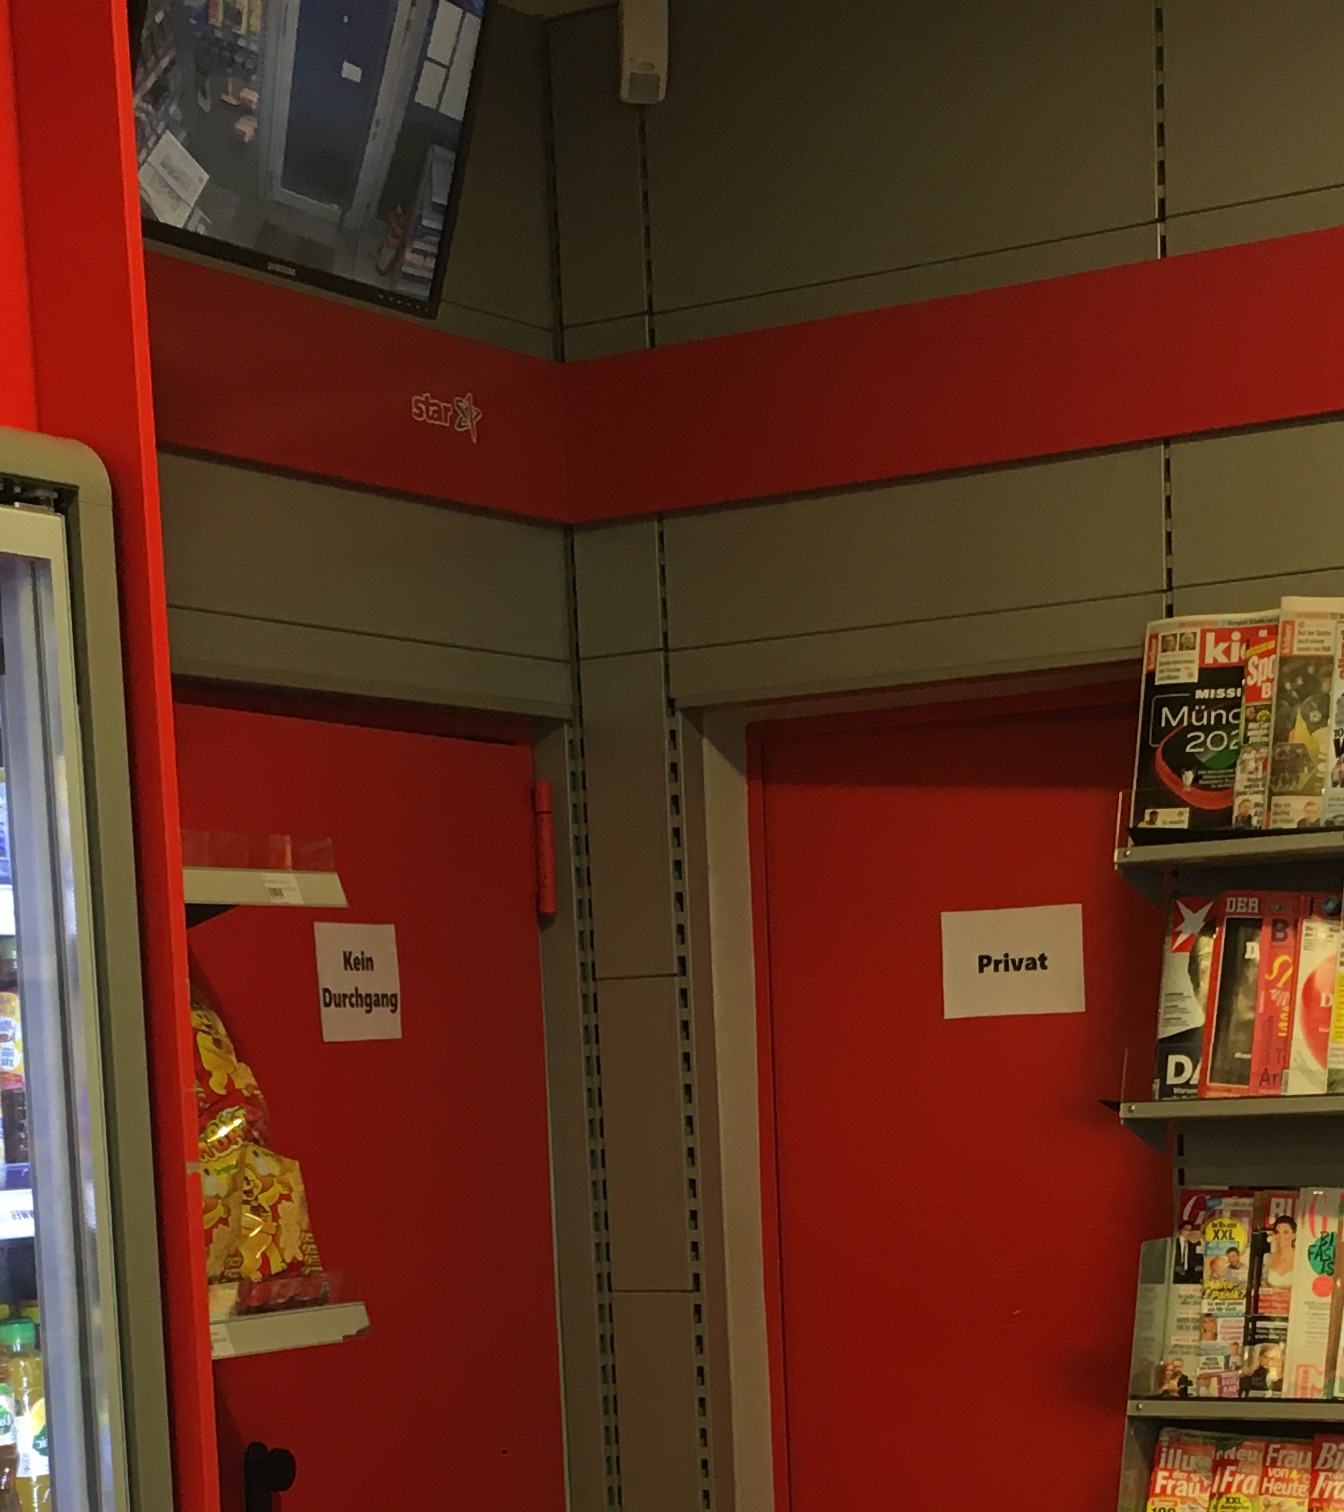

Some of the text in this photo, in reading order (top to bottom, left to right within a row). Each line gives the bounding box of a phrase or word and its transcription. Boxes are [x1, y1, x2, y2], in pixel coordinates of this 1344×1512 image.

[411, 393, 453, 428] star
[341, 950, 376, 974] Kein
[976, 950, 1049, 975] Privat
[321, 986, 399, 1014] Durchgang
[1261, 1478, 1308, 1496] Heute
